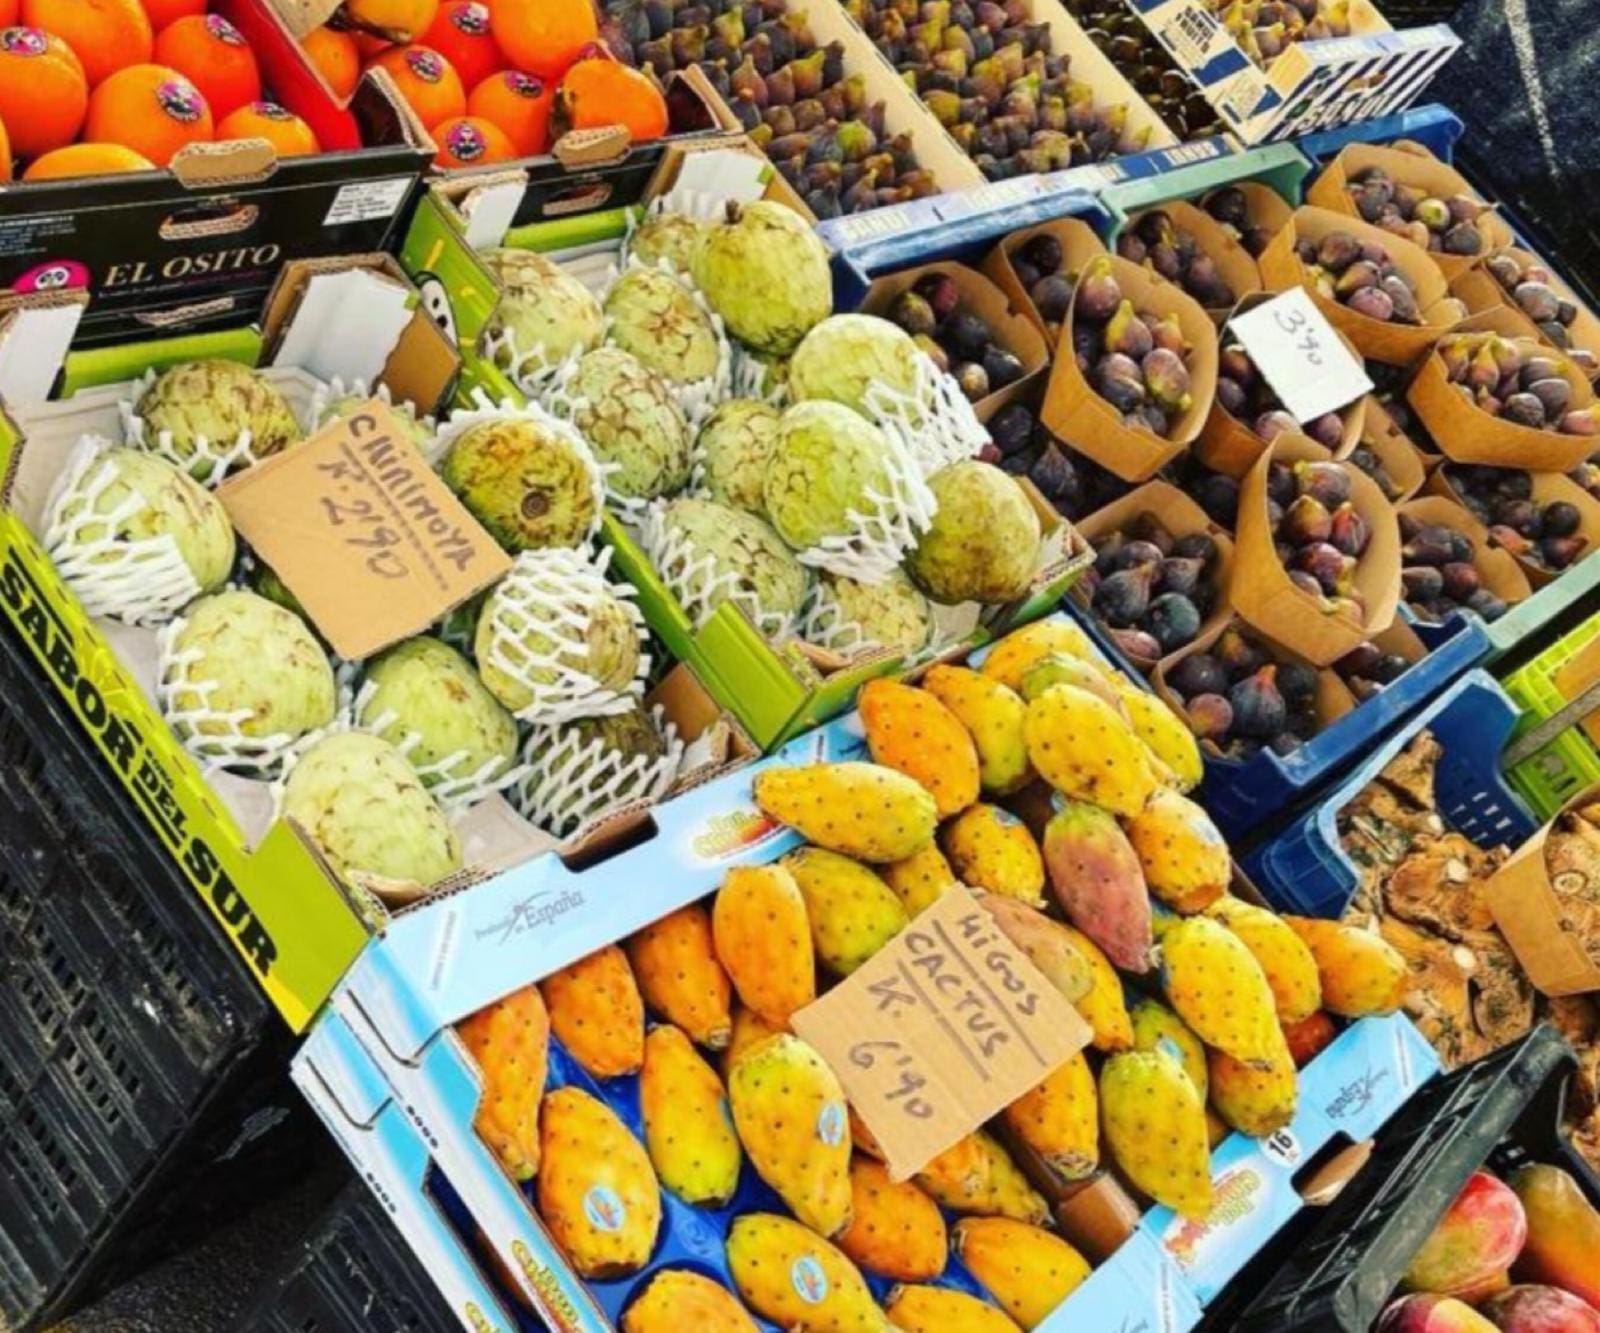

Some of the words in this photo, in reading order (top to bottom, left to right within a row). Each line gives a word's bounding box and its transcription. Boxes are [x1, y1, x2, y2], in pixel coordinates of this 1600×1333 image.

[103, 262, 154, 287] EL
[162, 243, 281, 279] OSITO
[1, 562, 136, 775] SABOR
[137, 758, 188, 839] DEL
[183, 837, 278, 977] SUR
[525, 890, 585, 929] España
[904, 931, 1011, 1057] CACTUS
[849, 1040, 934, 1119] 6'90
[1268, 1131, 1293, 1157] 16
